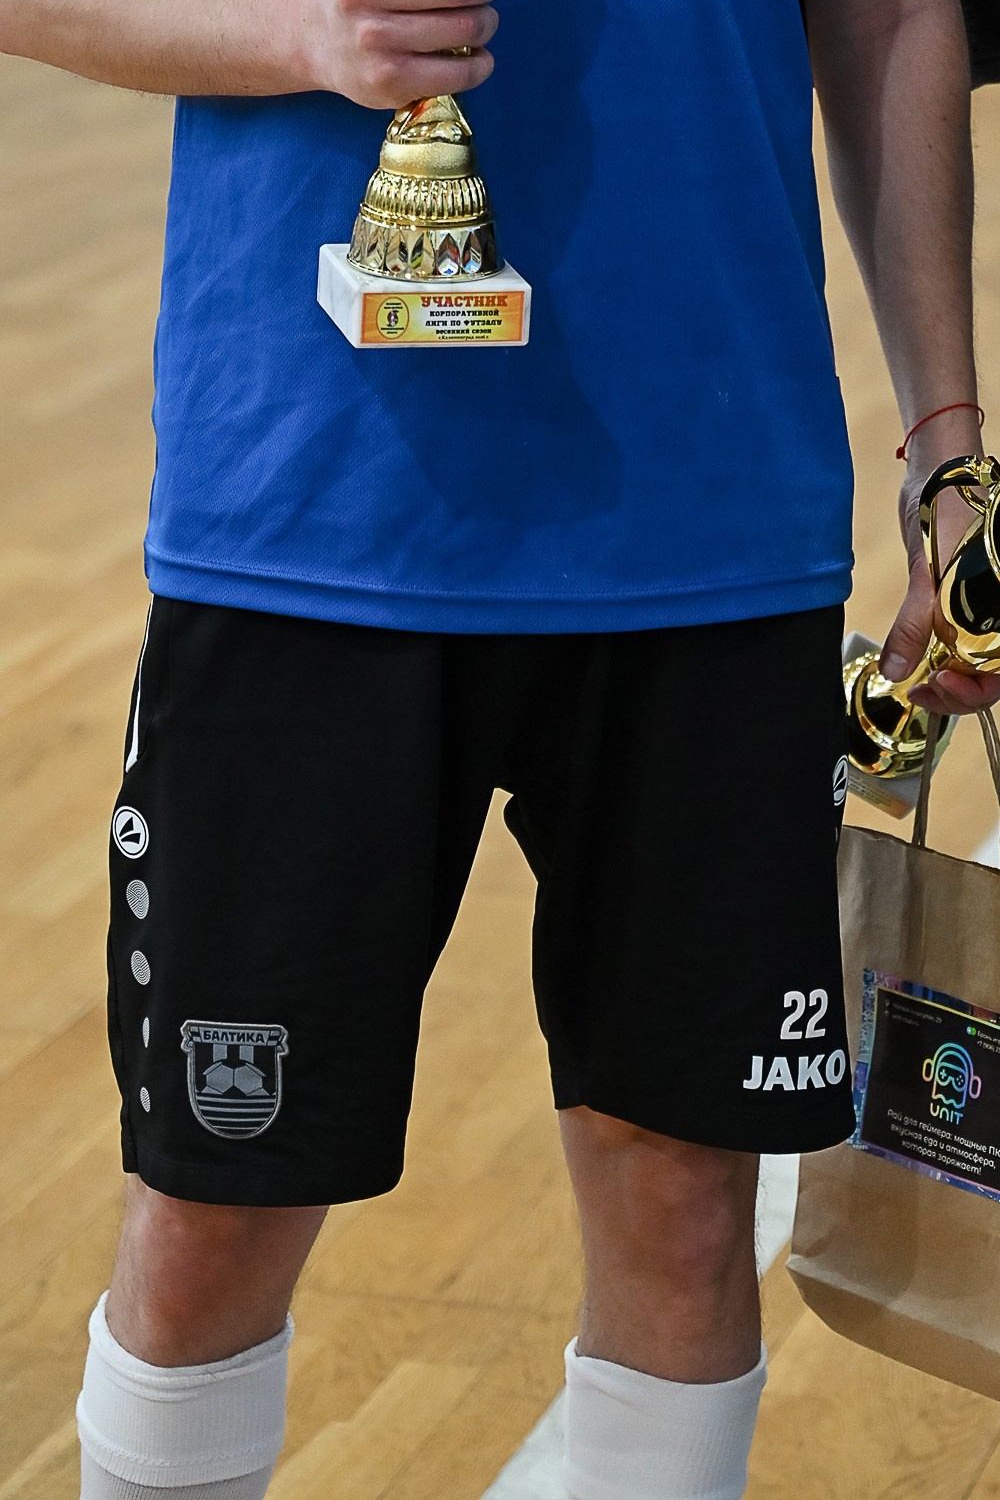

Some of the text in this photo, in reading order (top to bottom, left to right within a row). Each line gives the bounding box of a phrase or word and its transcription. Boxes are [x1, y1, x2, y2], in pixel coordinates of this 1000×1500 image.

[421, 295, 508, 308] УЧАСТНИК
[429, 309, 500, 317] КОРПОРАТИВНОЙ
[780, 988, 829, 1040] 22
[203, 1030, 265, 1043] БАЛТИКА
[743, 1049, 846, 1091] JAKO
[887, 1108, 903, 1121] Рай
[903, 1116, 918, 1126] для
[953, 1135, 987, 1153] мощные
[890, 1123, 996, 1170] вкусная еда и атмосфера,
[901, 1140, 982, 1176] которая заряжает!
